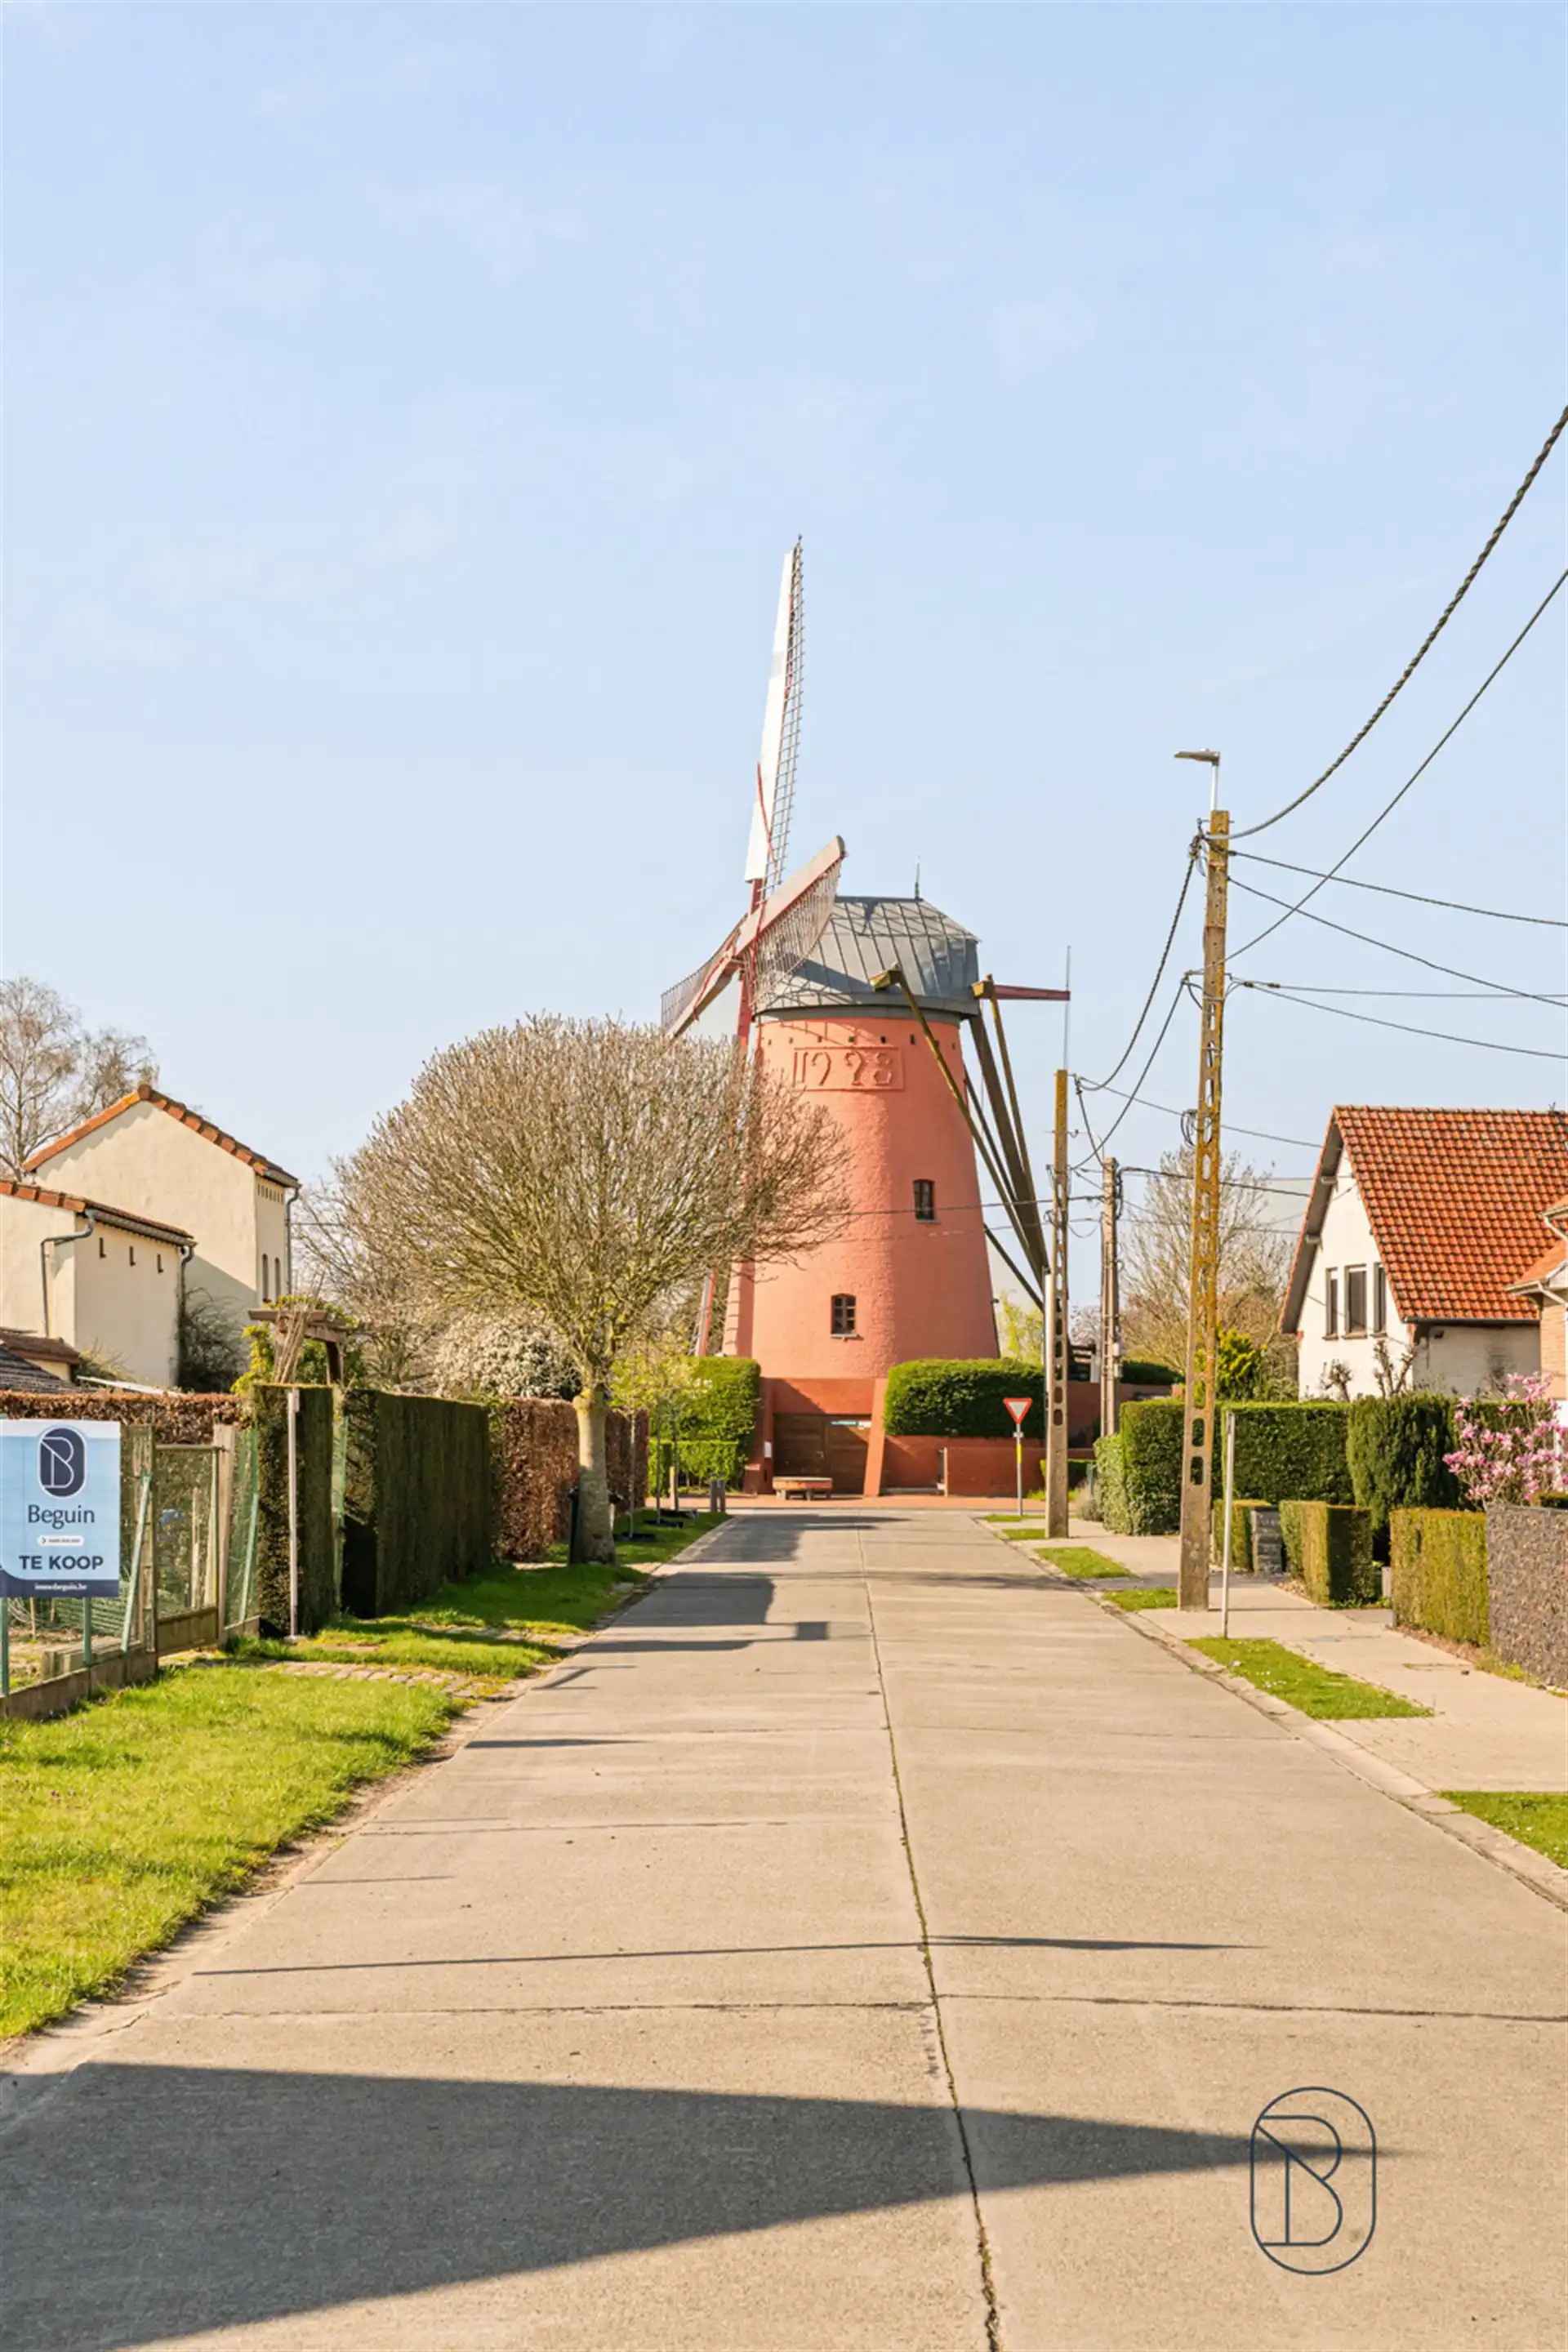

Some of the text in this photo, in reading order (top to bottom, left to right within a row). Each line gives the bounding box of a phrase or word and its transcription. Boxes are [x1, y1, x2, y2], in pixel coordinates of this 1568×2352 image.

[28, 1504, 96, 1530] Beguin
[18, 1555, 104, 1570] TE KOOP
